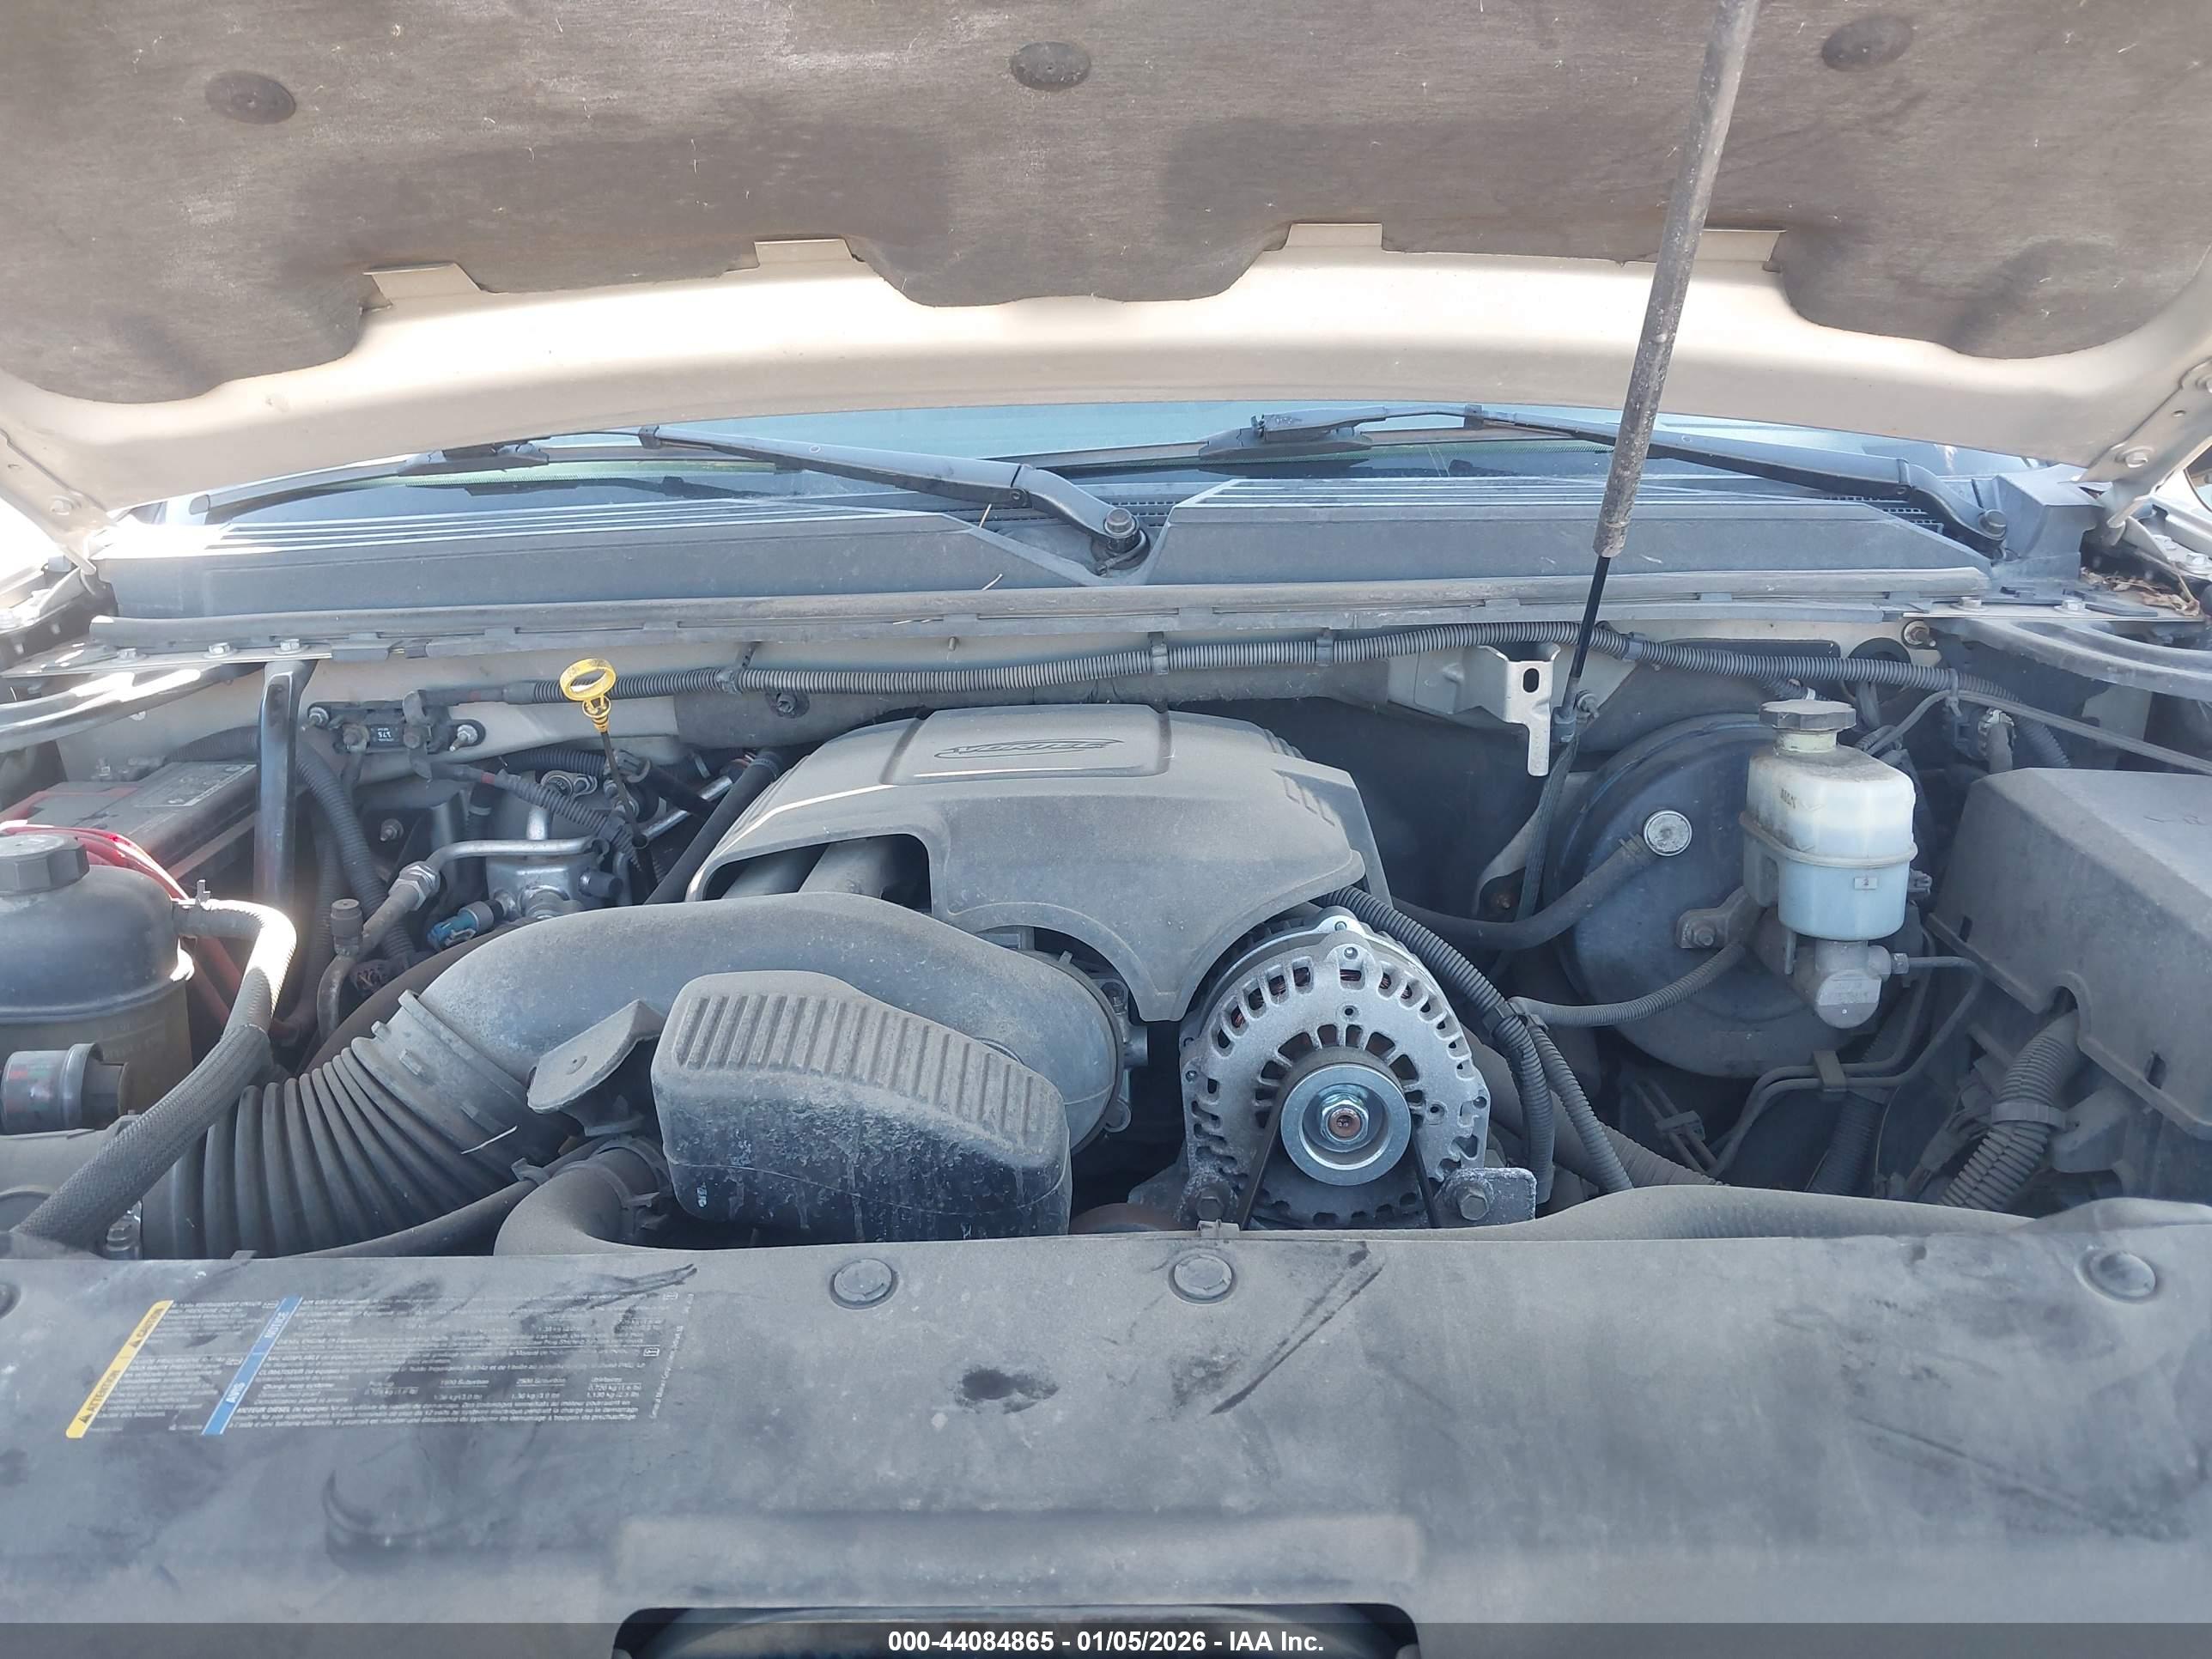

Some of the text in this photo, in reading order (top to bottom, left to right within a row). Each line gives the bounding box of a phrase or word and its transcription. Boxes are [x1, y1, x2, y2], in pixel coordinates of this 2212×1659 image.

[137, 1307, 165, 1339] CAUTION
[264, 1311, 289, 1339] NOTICE
[88, 1369, 121, 1413] ATTENTION
[226, 1381, 246, 1404] AVIS
